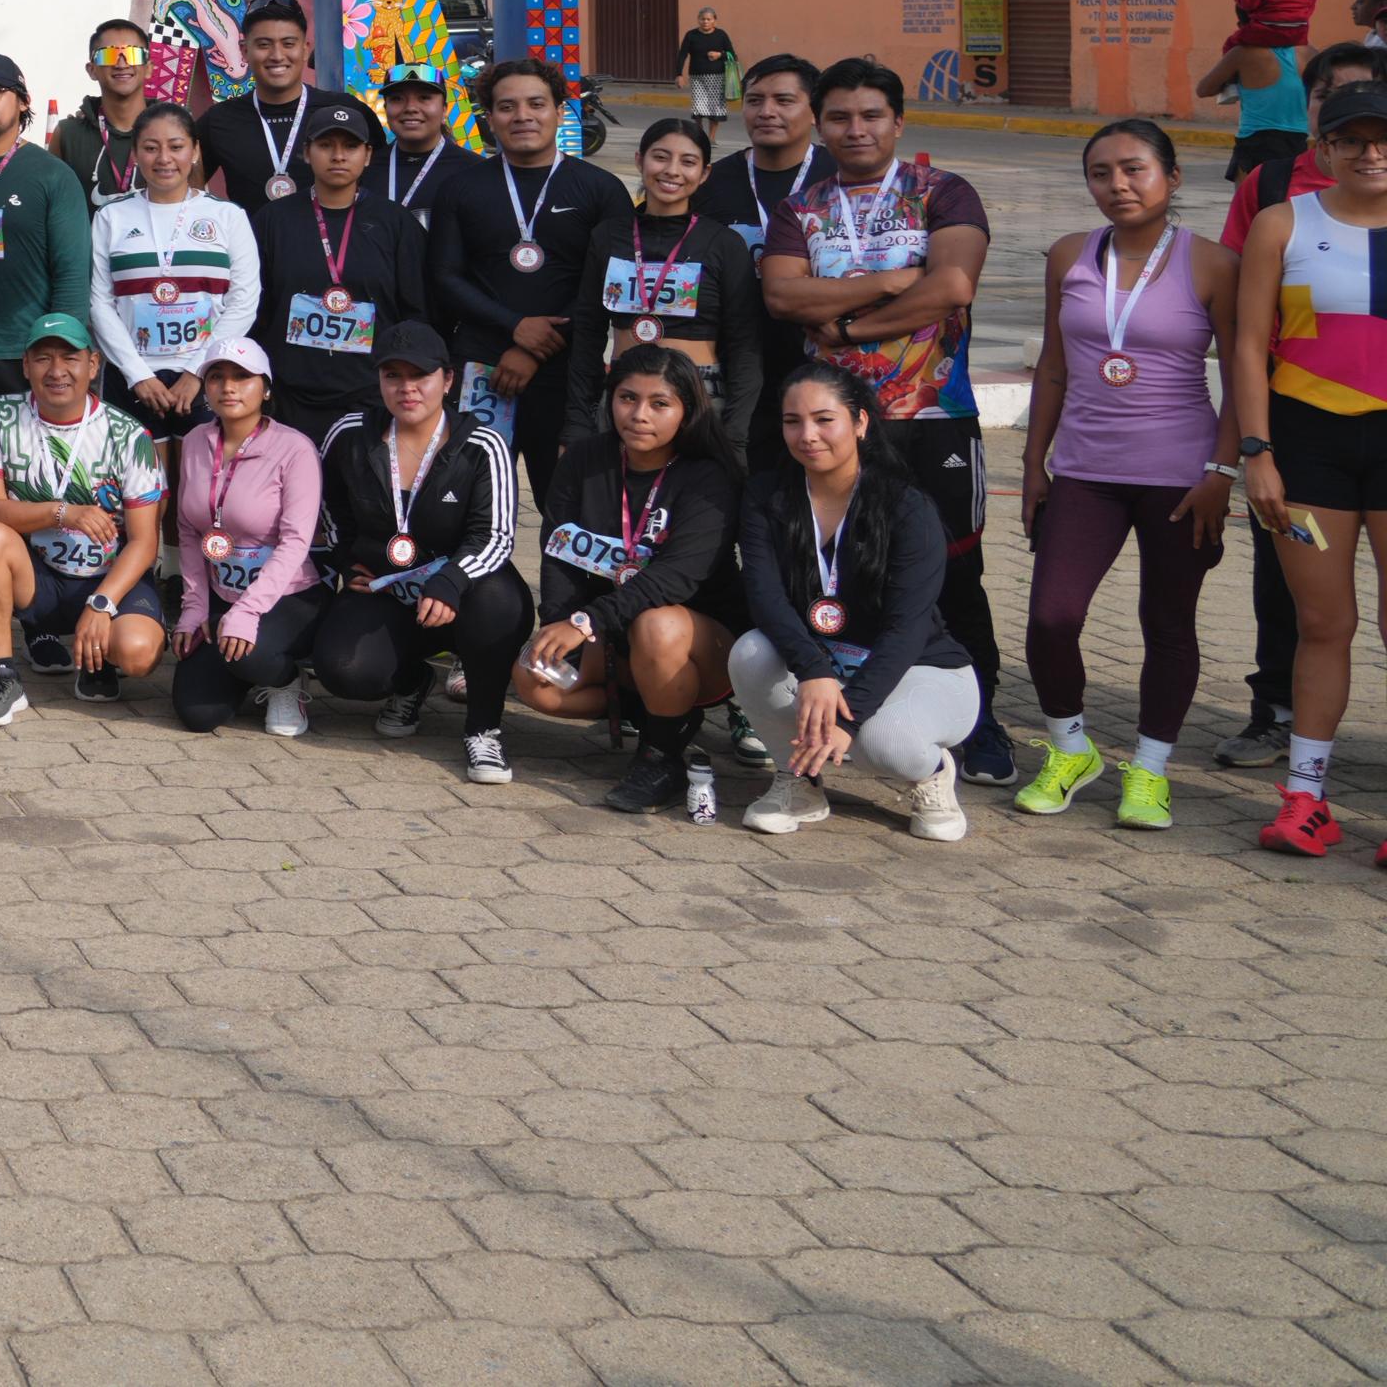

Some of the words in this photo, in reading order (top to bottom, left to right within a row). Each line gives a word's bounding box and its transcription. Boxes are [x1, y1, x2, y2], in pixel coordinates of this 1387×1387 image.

[156, 319, 198, 346] 136
[306, 312, 357, 342] 057
[51, 541, 103, 569] 245
